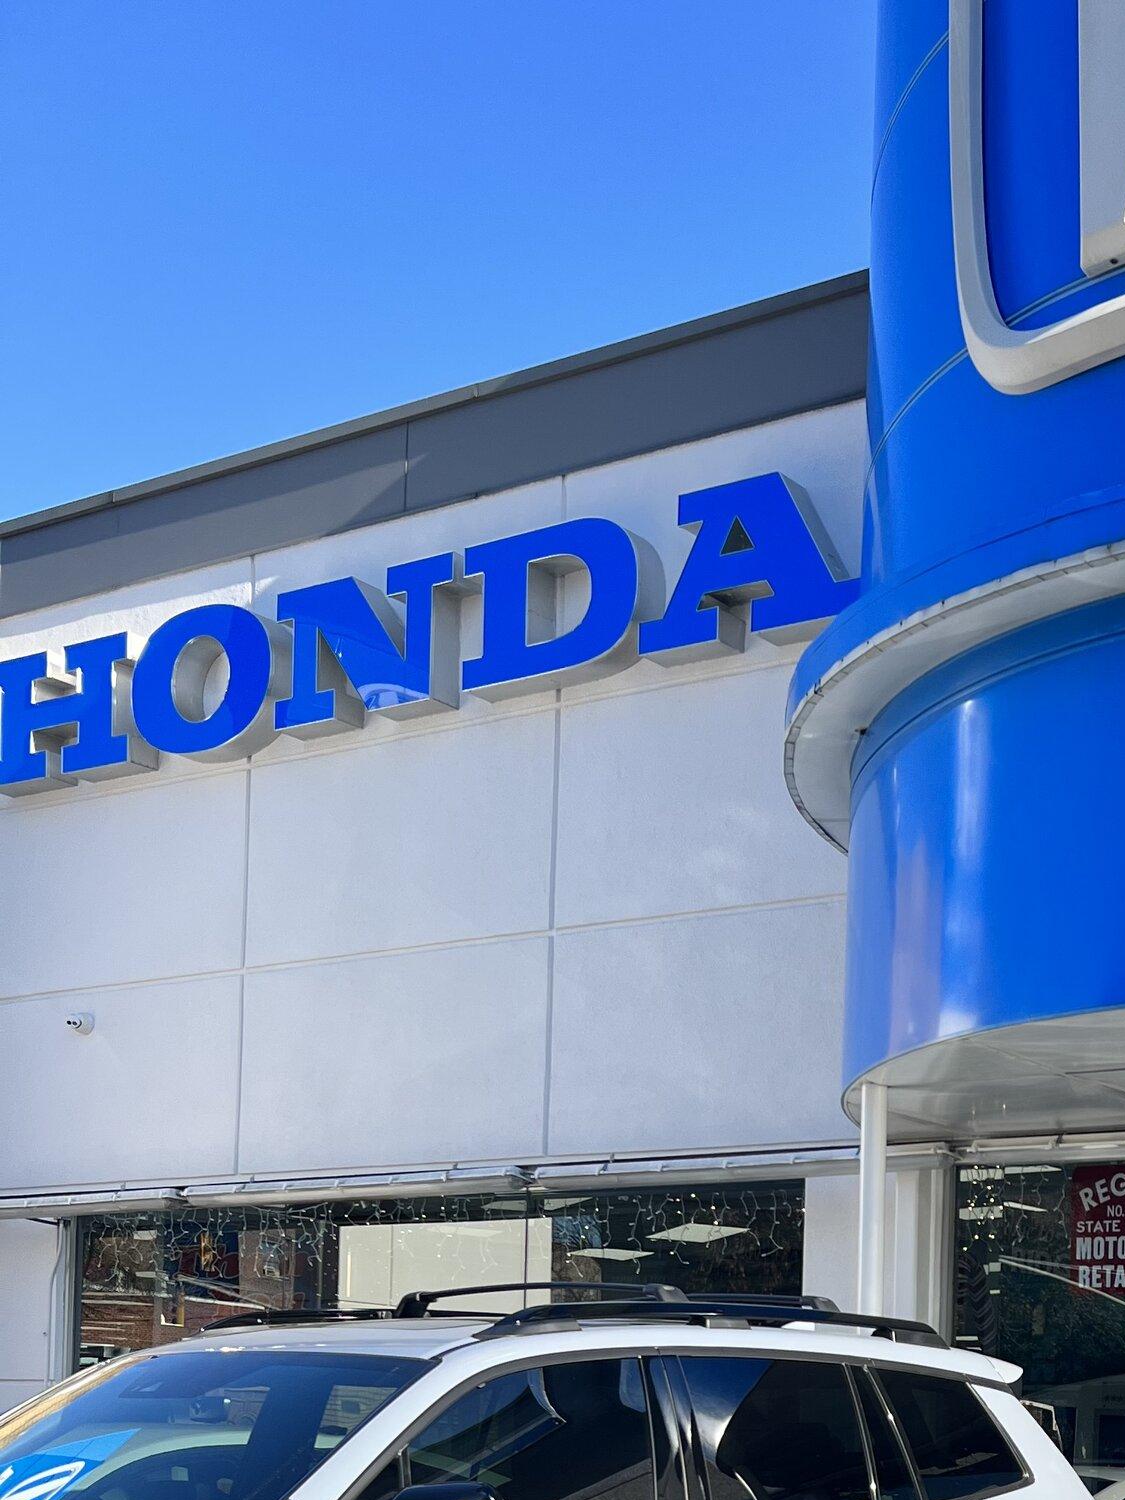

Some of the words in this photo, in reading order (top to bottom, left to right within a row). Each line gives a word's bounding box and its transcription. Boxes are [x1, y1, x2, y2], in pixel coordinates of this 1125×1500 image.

[0, 471, 861, 785] HONDA
[1106, 1204, 1125, 1218] NO.
[1076, 1219, 1120, 1233] STATE
